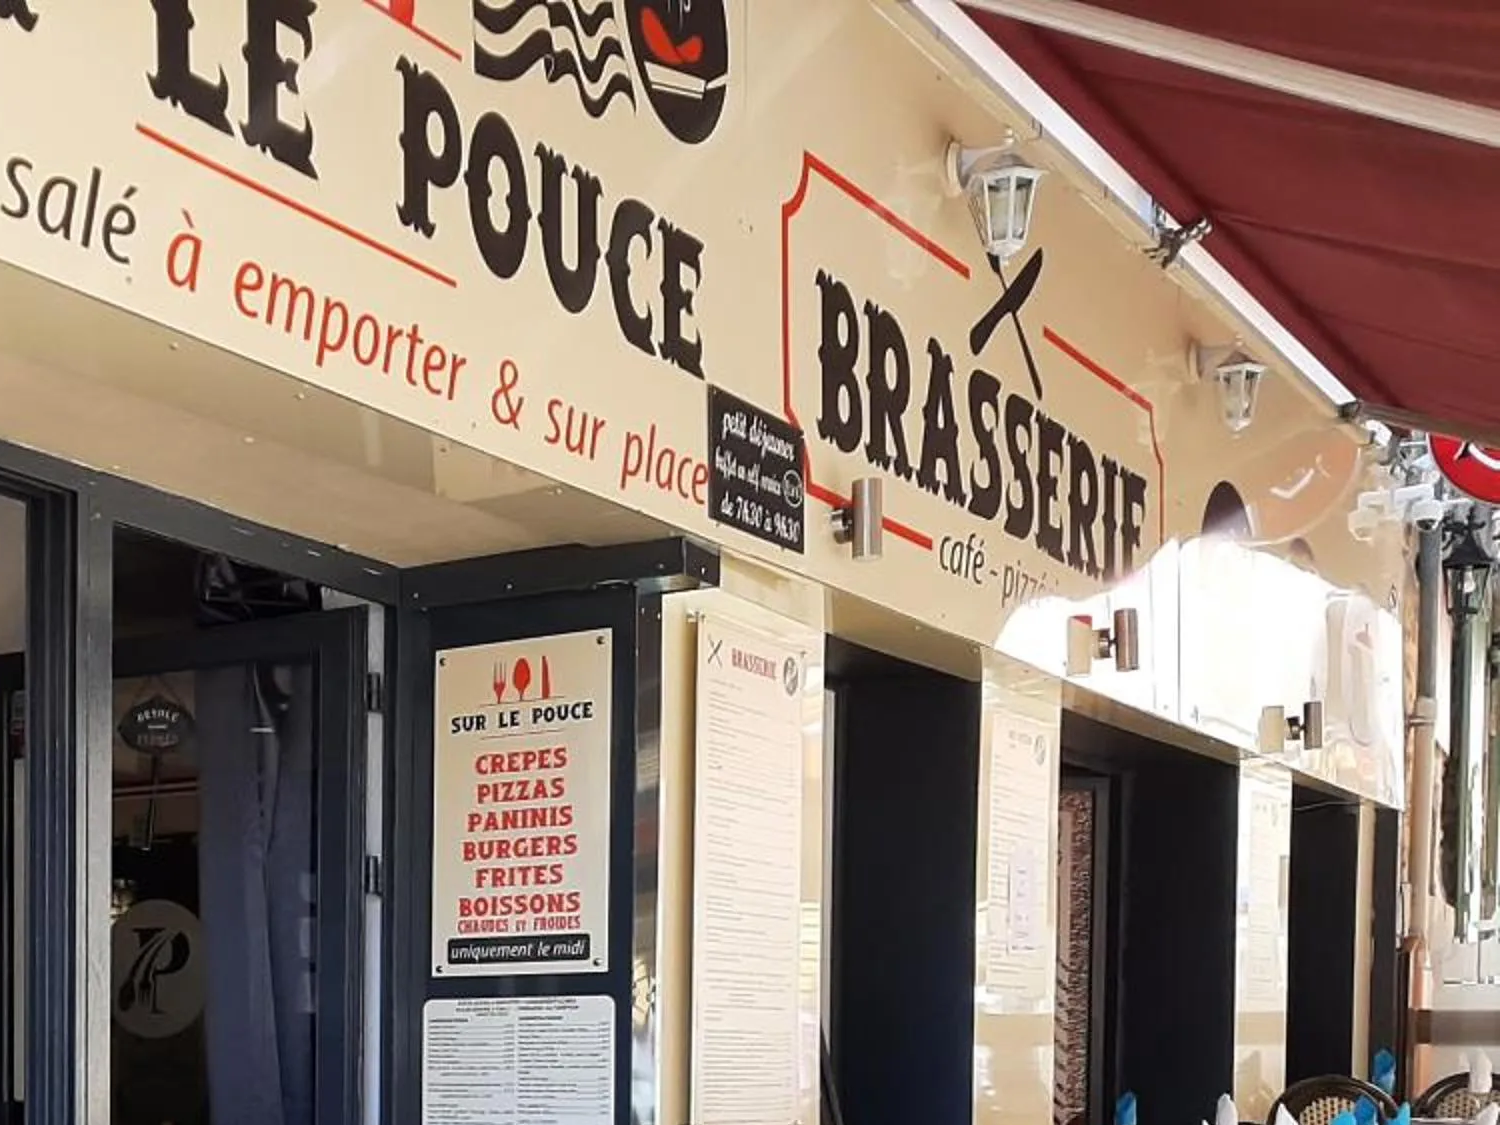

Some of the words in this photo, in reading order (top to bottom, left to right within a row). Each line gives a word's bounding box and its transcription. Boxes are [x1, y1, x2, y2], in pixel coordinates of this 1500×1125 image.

[145, 0, 319, 181] LE
[395, 54, 706, 381] POUCE
[0, 155, 139, 265] salé
[166, 208, 203, 293] à
[233, 259, 468, 402] emporter
[491, 359, 525, 430] &
[545, 397, 606, 461] sur
[619, 423, 709, 506] place
[721, 411, 748, 441] petit
[814, 267, 1152, 586] BRASSERIE
[720, 490, 735, 518] de
[735, 495, 764, 530] 7h30
[763, 509, 774, 534] à
[773, 511, 801, 544] 9h30
[939, 532, 985, 585] café
[731, 647, 778, 680] BRASSERIE
[451, 715, 487, 735] SUR
[498, 709, 521, 729] LE
[532, 700, 594, 725] POUCE
[474, 746, 568, 776] CREPES
[476, 777, 566, 805] PIZZAS
[467, 804, 574, 833] PANINIS
[462, 834, 578, 862] BURGERS
[474, 863, 564, 889] FRITES
[458, 891, 581, 918] BOISSONS
[457, 919, 509, 934] CHAUDES
[533, 915, 581, 931] FROIDES
[451, 942, 532, 963] uniquement
[537, 941, 549, 957] le
[553, 939, 587, 956] midi
